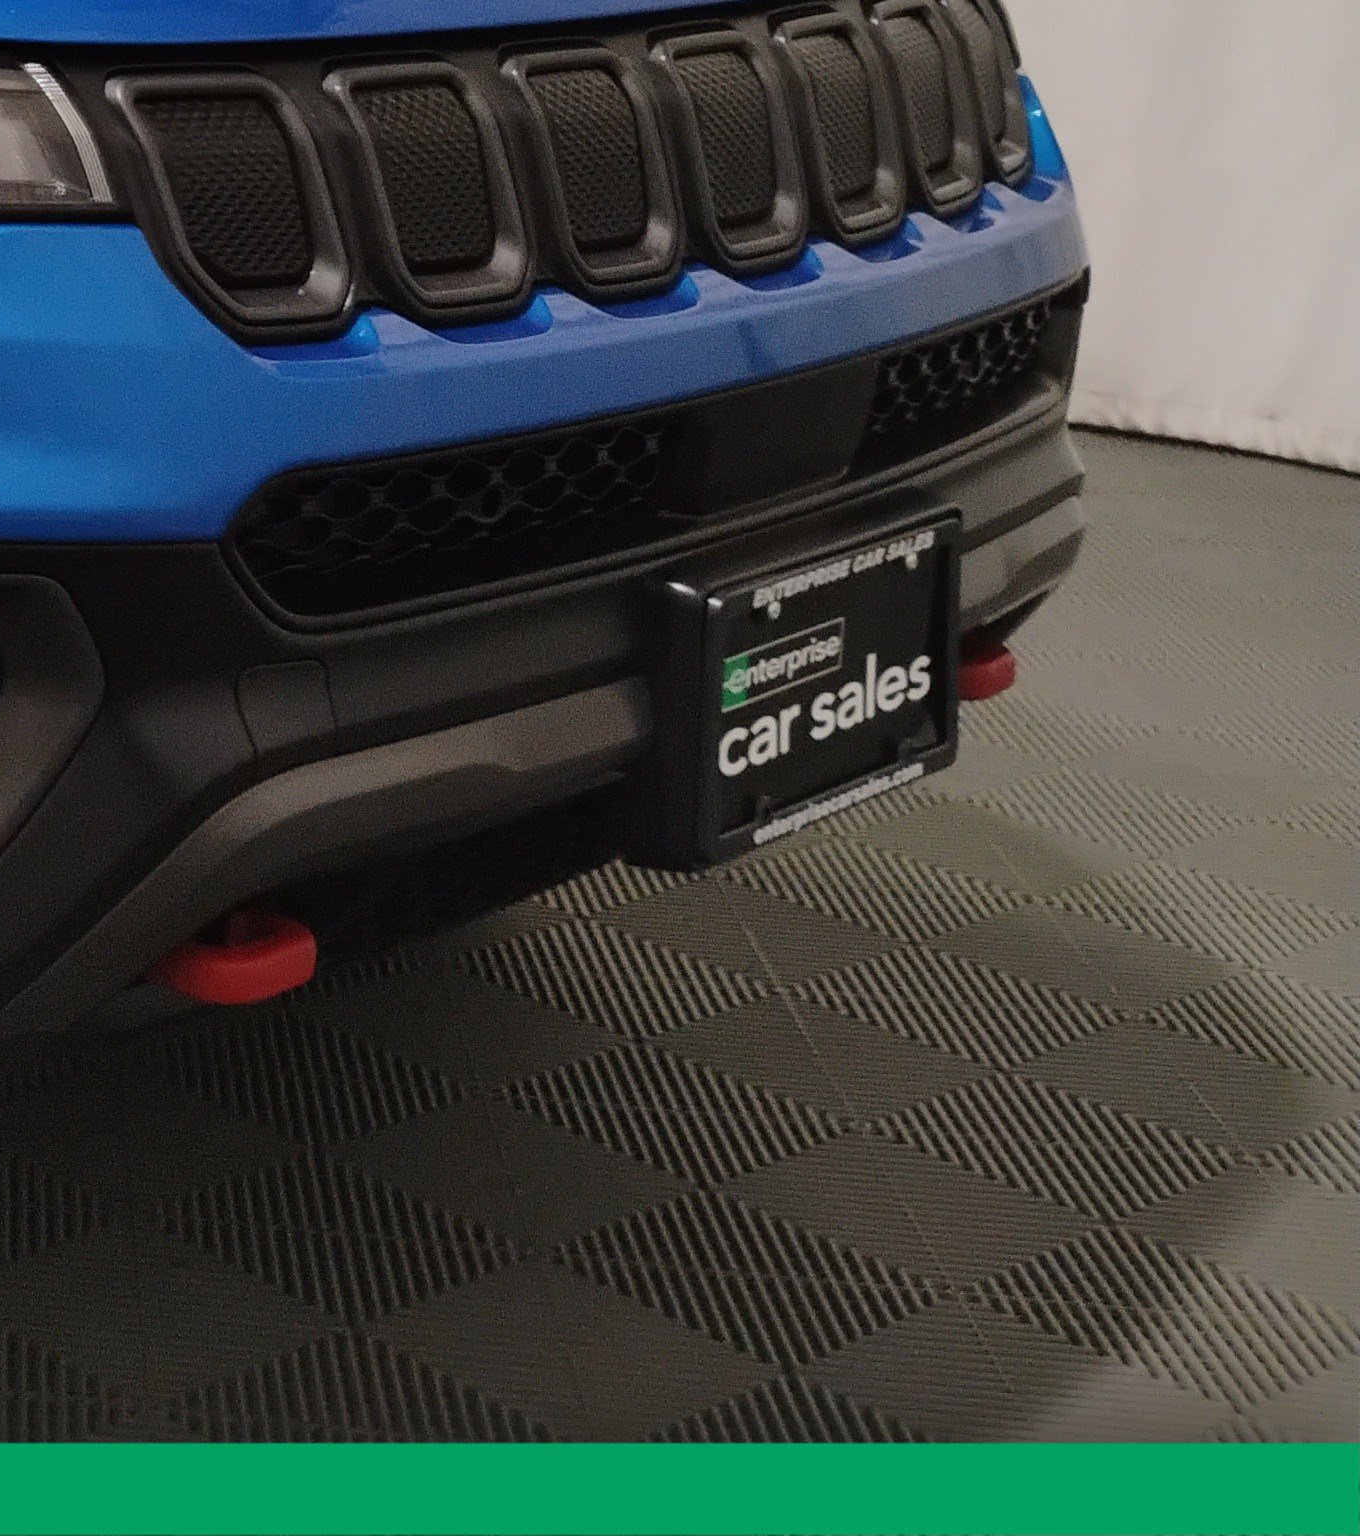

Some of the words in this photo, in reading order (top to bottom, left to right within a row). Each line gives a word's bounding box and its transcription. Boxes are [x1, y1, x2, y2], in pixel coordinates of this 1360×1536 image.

[725, 635, 843, 694] enterprise
[718, 703, 802, 778] car
[808, 652, 931, 741] sales
